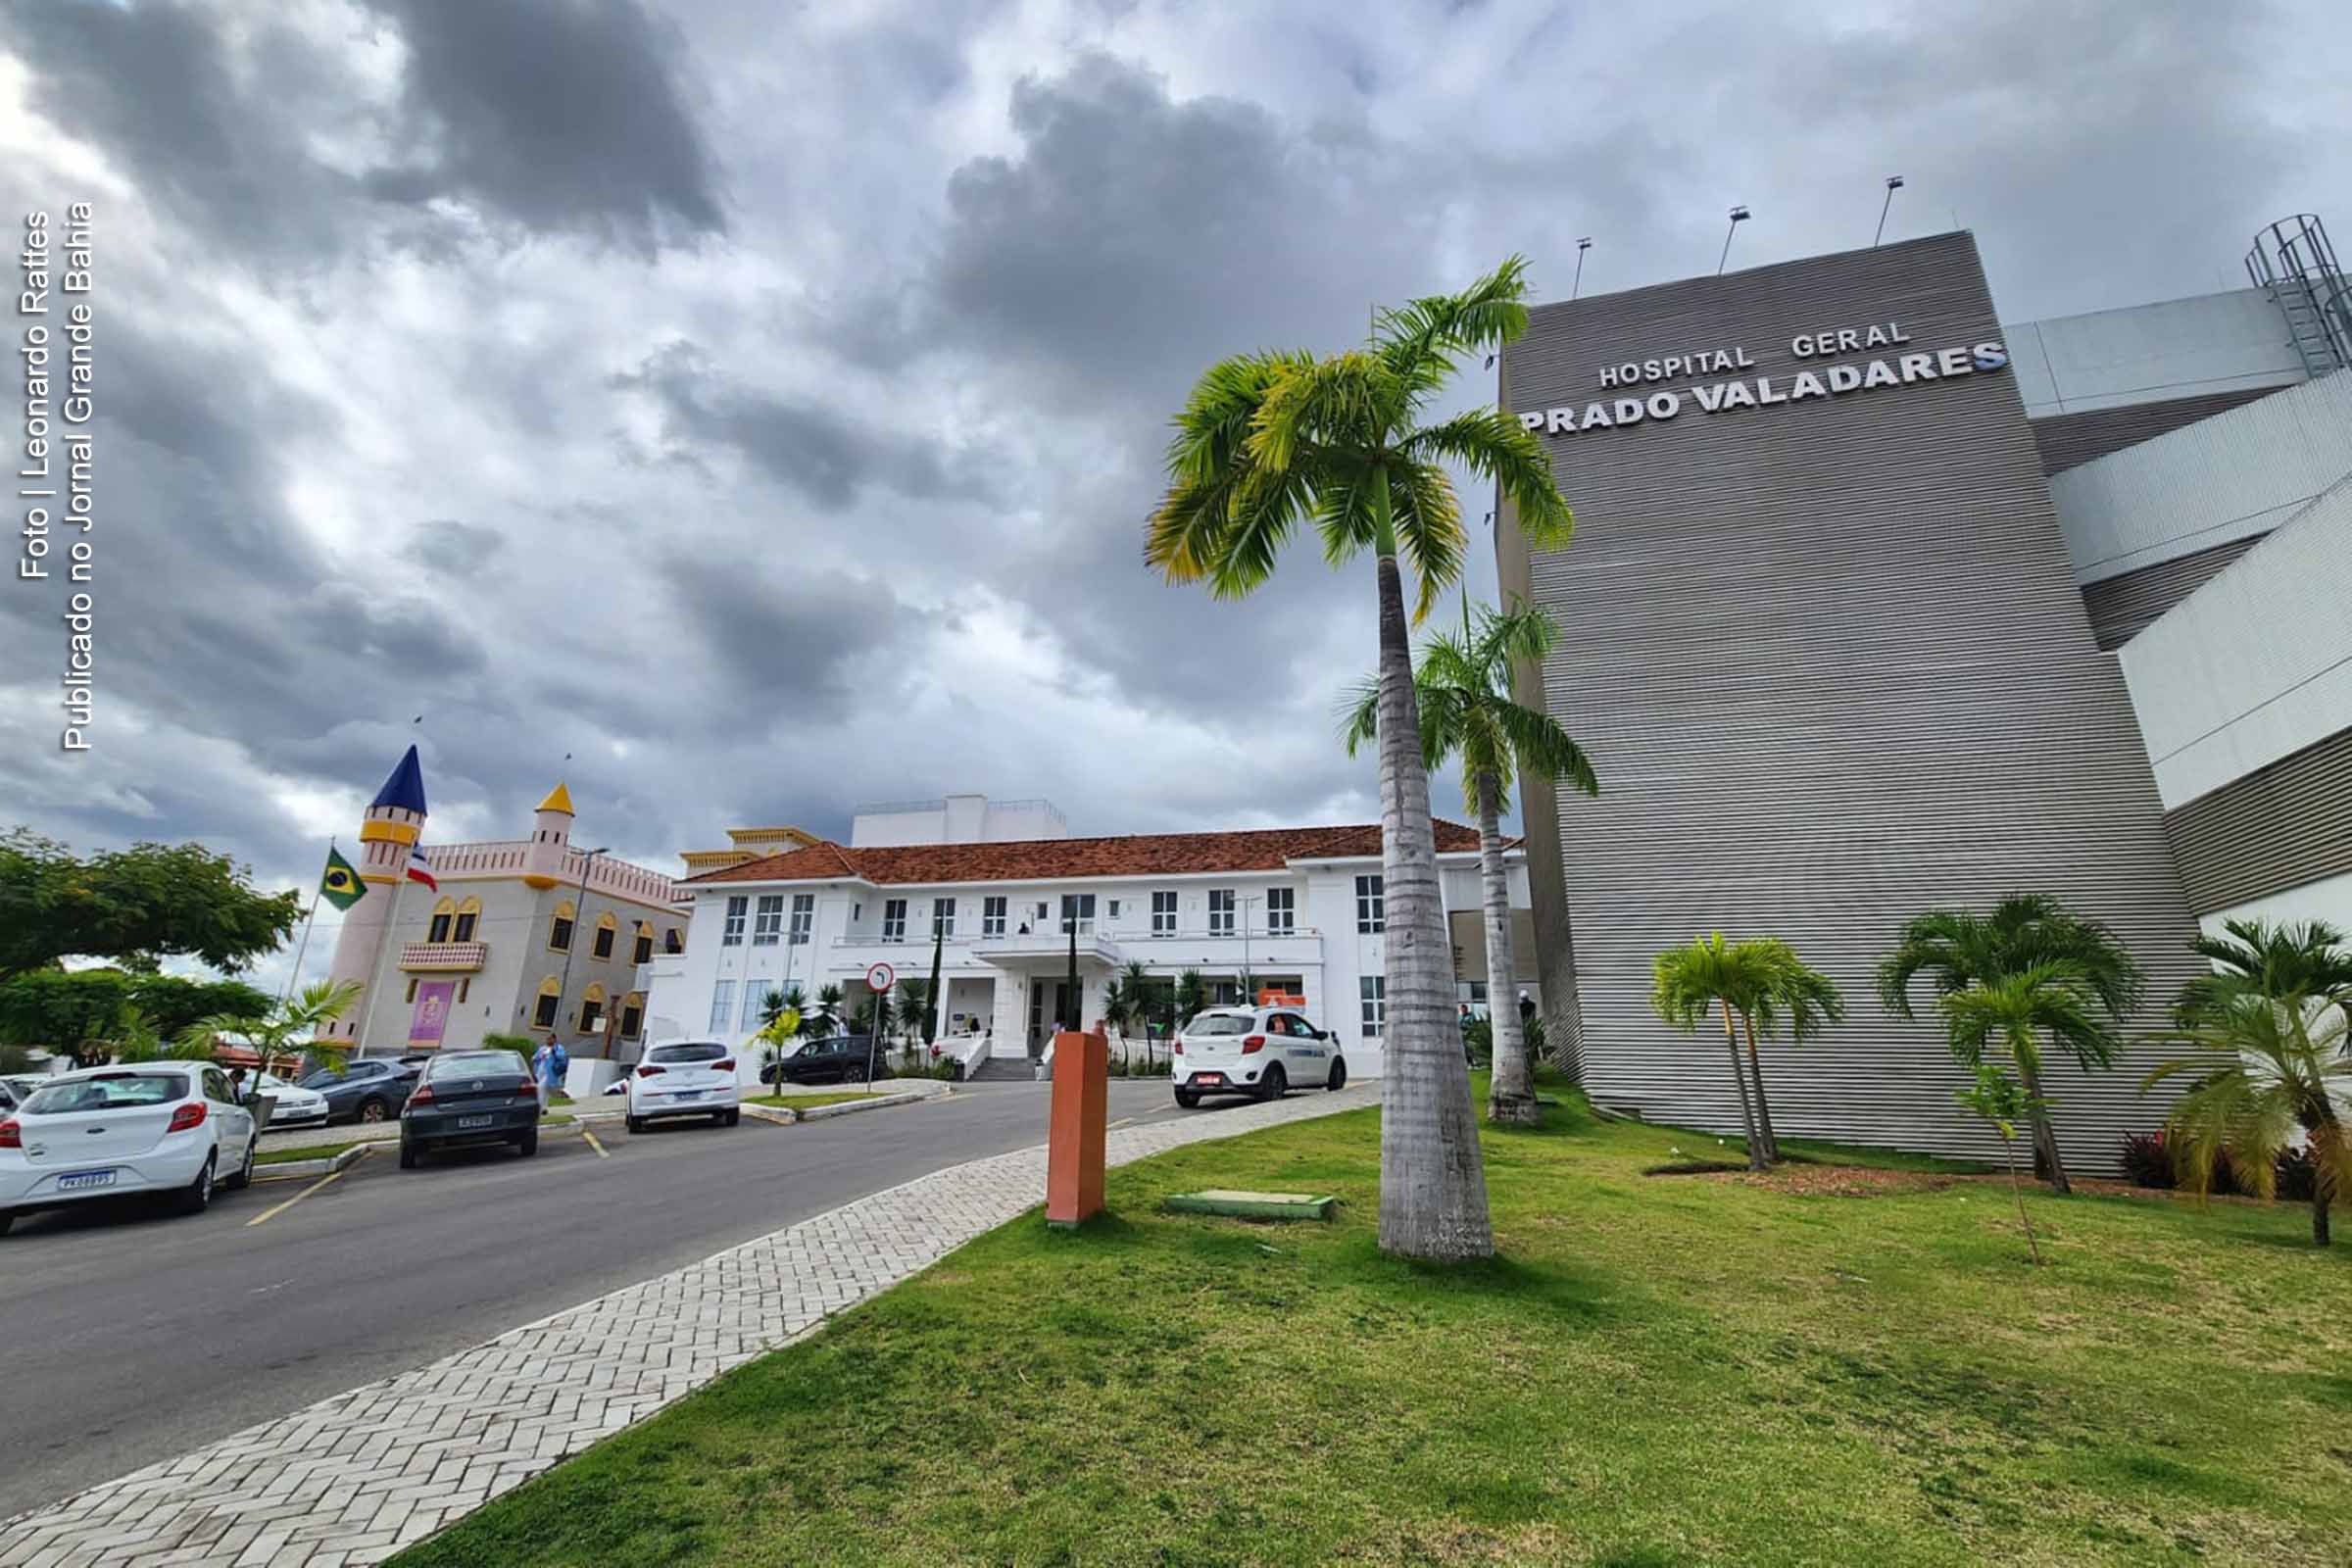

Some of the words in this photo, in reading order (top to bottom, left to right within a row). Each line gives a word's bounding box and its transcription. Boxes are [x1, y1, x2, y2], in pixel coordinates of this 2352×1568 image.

[1519, 392, 1681, 434] PRADO
[1690, 341, 2008, 412] VALADARES
[1599, 346, 1755, 387] HOSPITAL
[1791, 321, 1911, 359] GERAL
